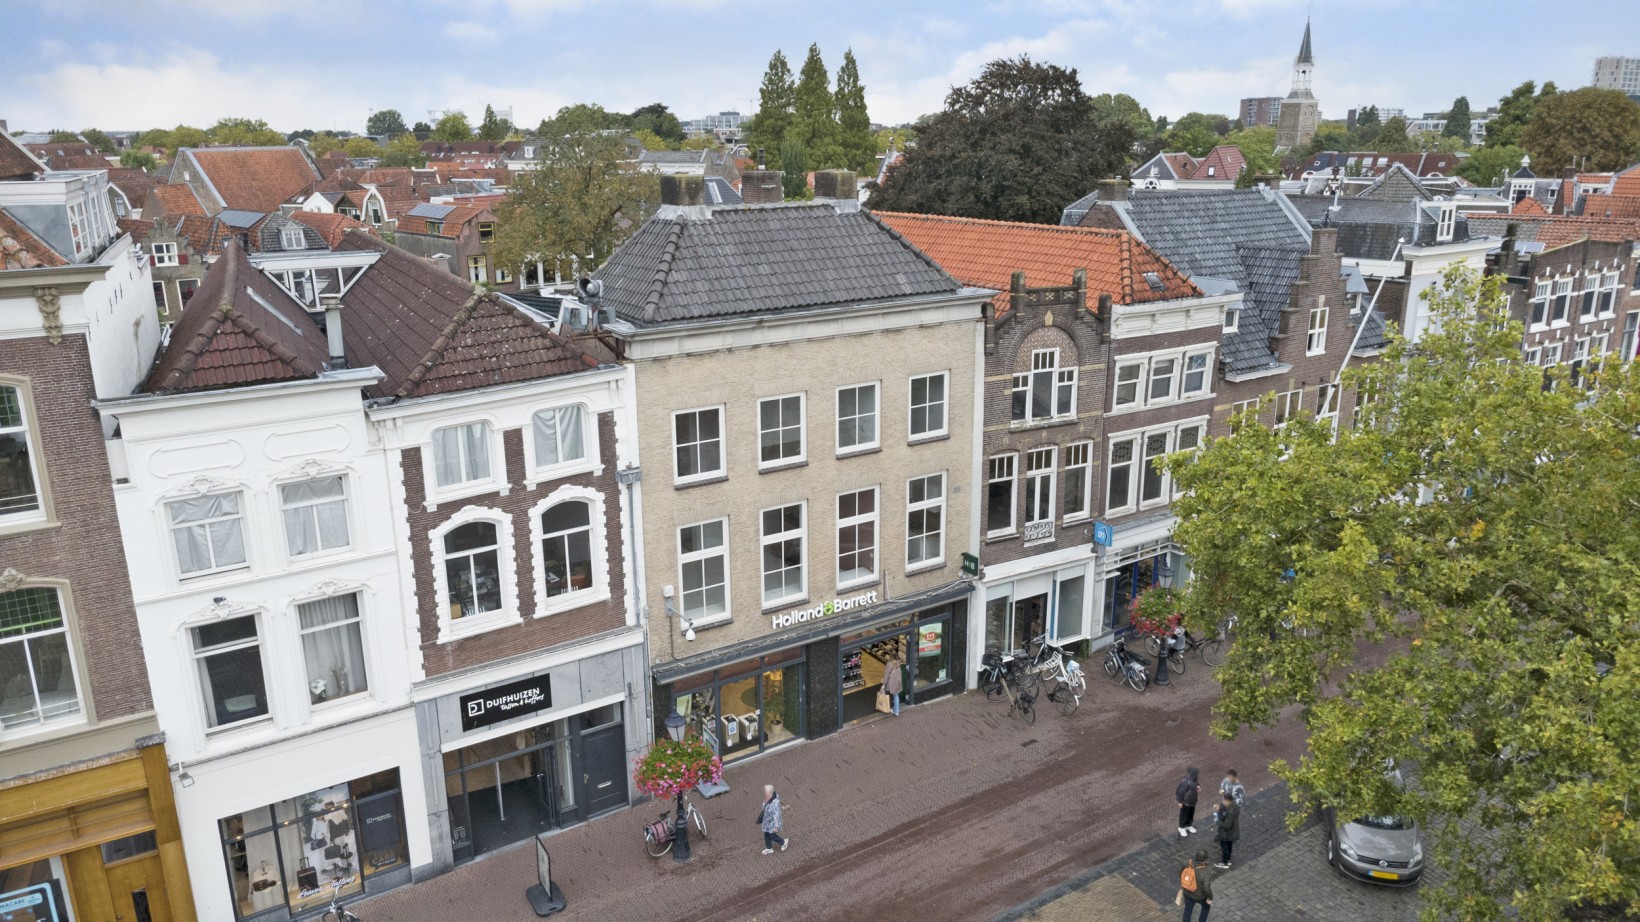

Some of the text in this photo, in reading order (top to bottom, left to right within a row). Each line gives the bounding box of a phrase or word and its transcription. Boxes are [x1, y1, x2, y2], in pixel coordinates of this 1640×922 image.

[772, 603, 823, 630] Holland
[833, 590, 878, 613] Barrett
[486, 687, 540, 708] DUIFHUIZEN
